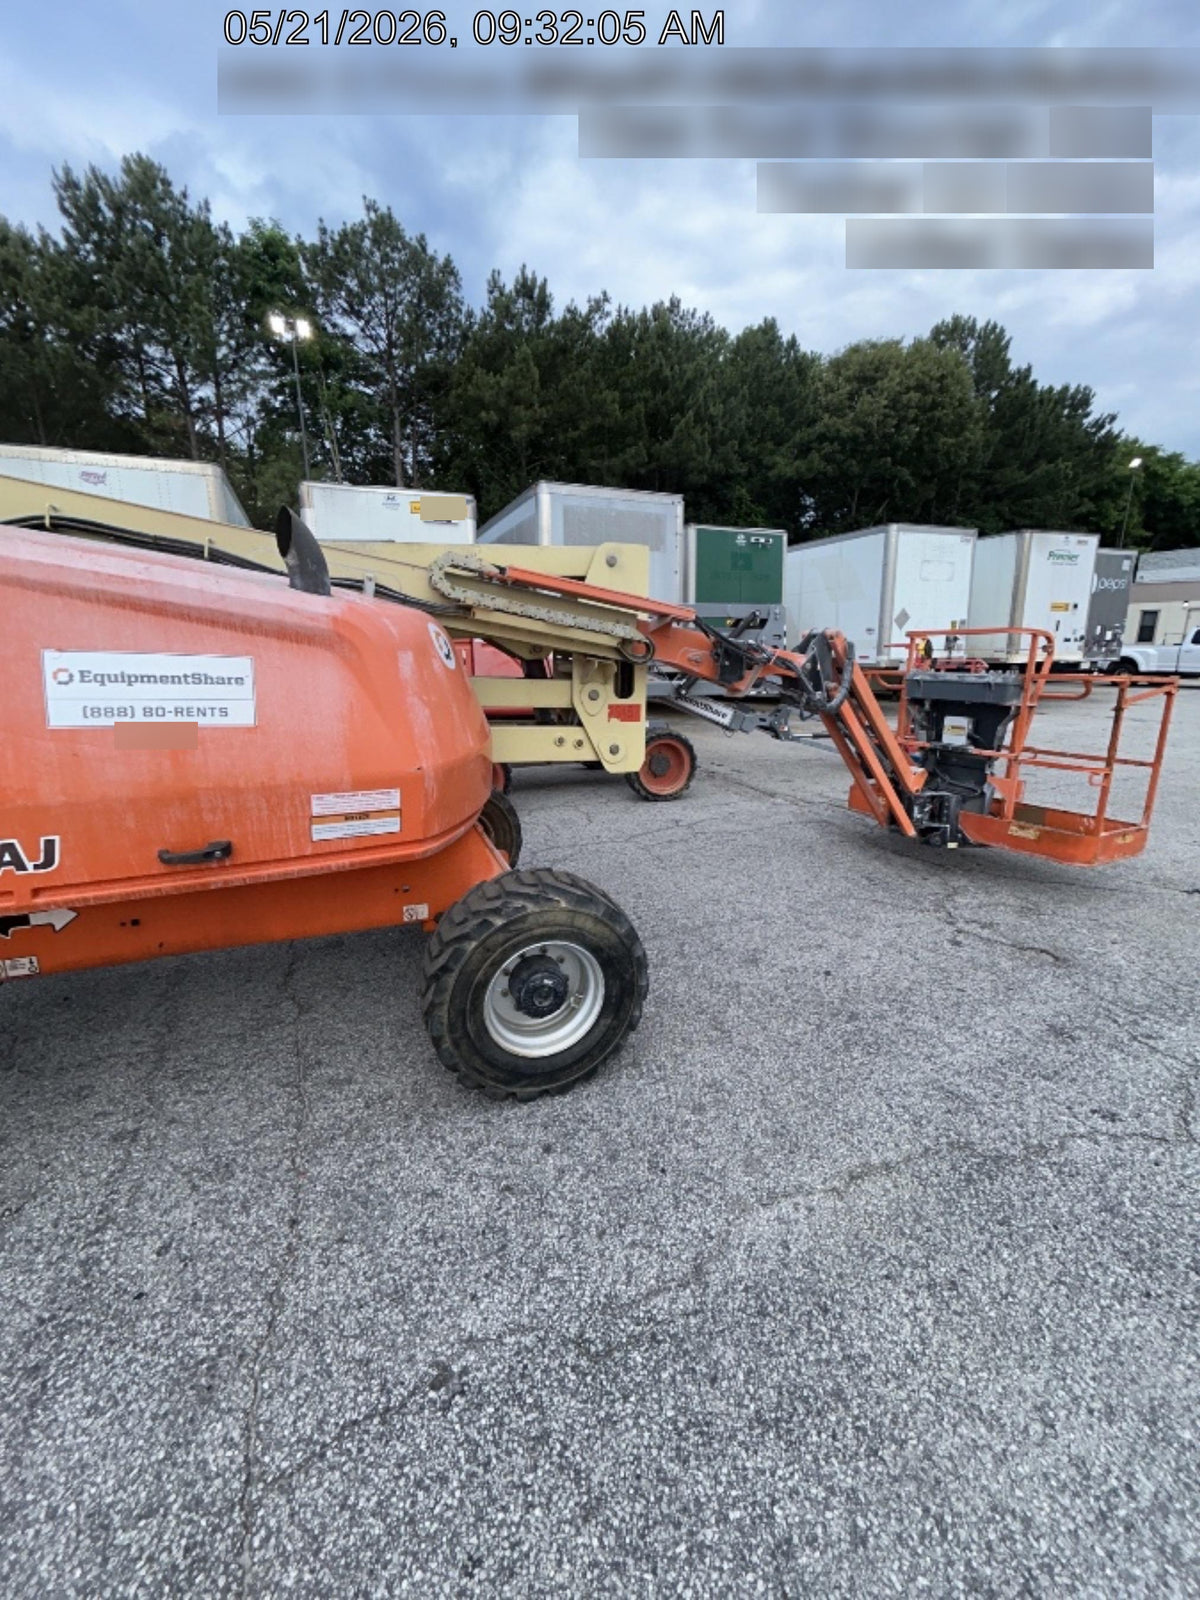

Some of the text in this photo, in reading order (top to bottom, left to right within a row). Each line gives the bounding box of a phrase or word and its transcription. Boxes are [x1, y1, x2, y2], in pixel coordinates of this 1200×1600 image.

[78, 669, 246, 687] EquipmentShare
[82, 705, 229, 719] (888) 80-RENTS
[0, 836, 60, 874] AJ
